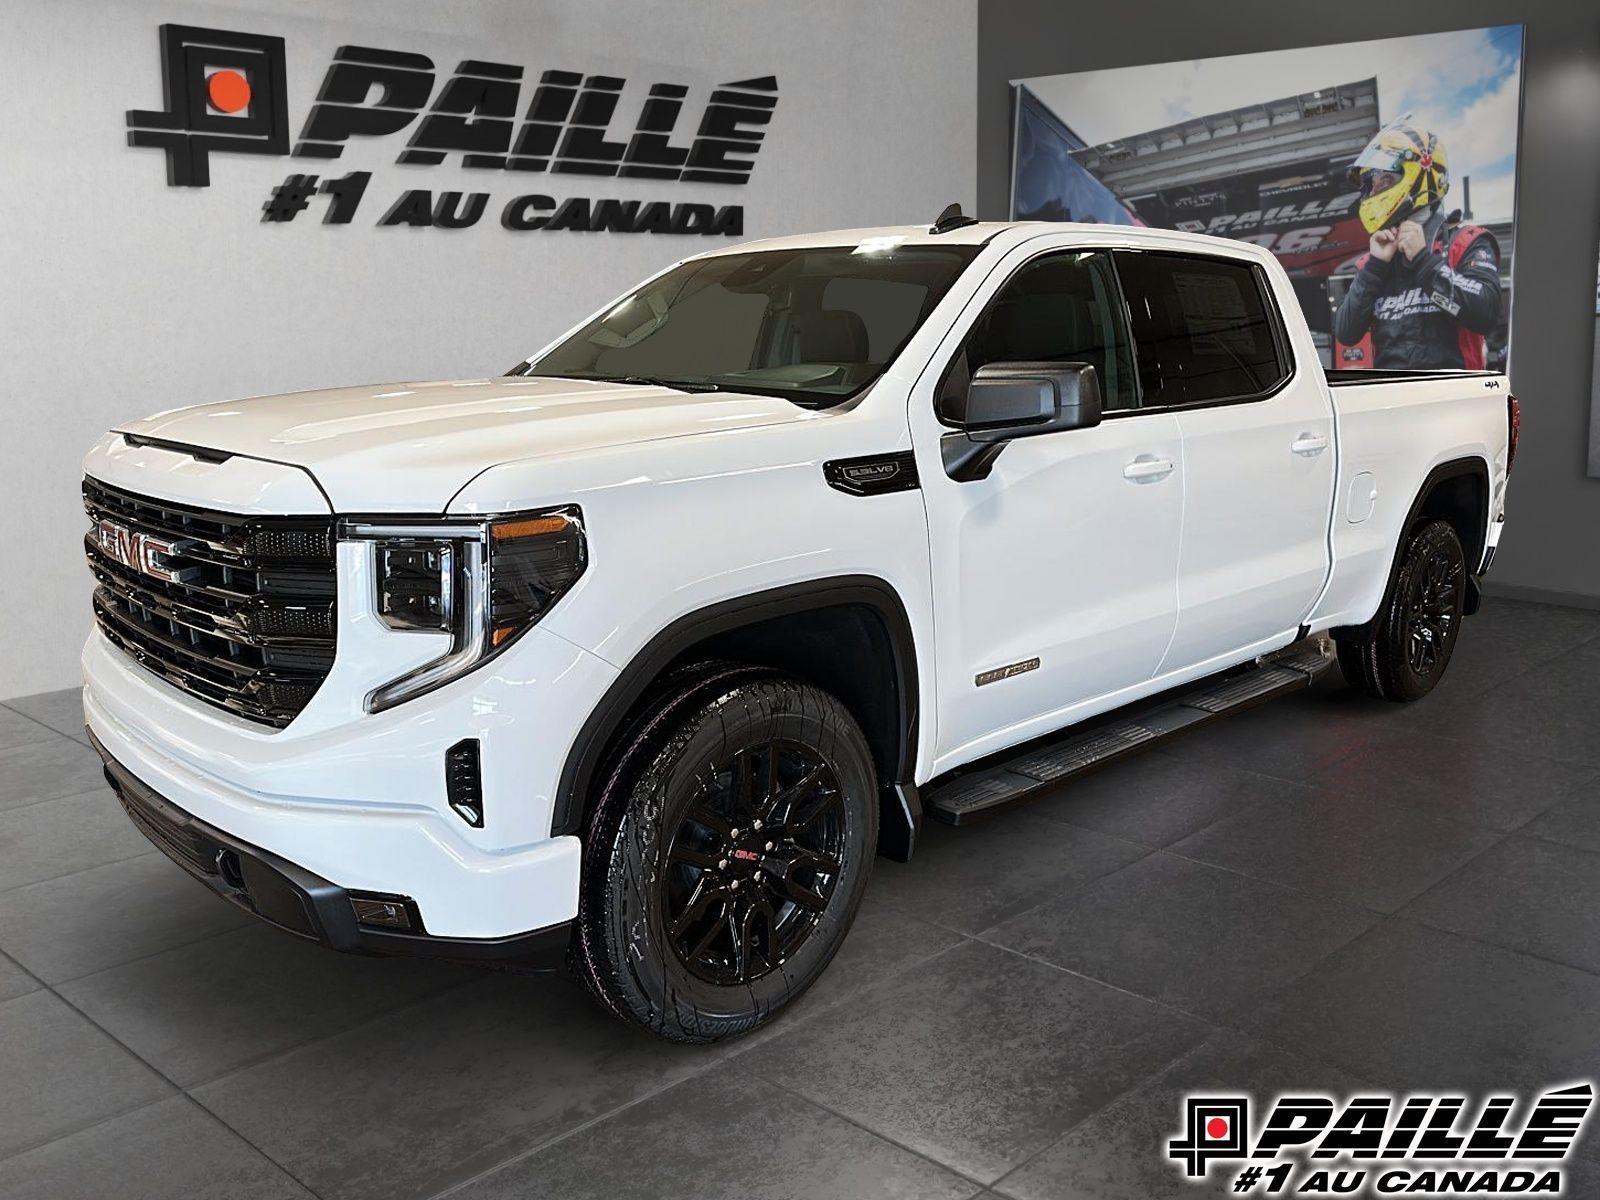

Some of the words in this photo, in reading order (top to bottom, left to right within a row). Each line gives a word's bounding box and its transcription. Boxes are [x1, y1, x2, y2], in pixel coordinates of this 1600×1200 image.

[291, 44, 779, 185] PAILLÉ
[260, 171, 373, 225] #1
[375, 189, 491, 230] AU
[500, 193, 744, 236] CANADA
[1263, 209, 1349, 226] CANADA
[98, 519, 181, 584] GMC
[734, 849, 759, 861] GMC
